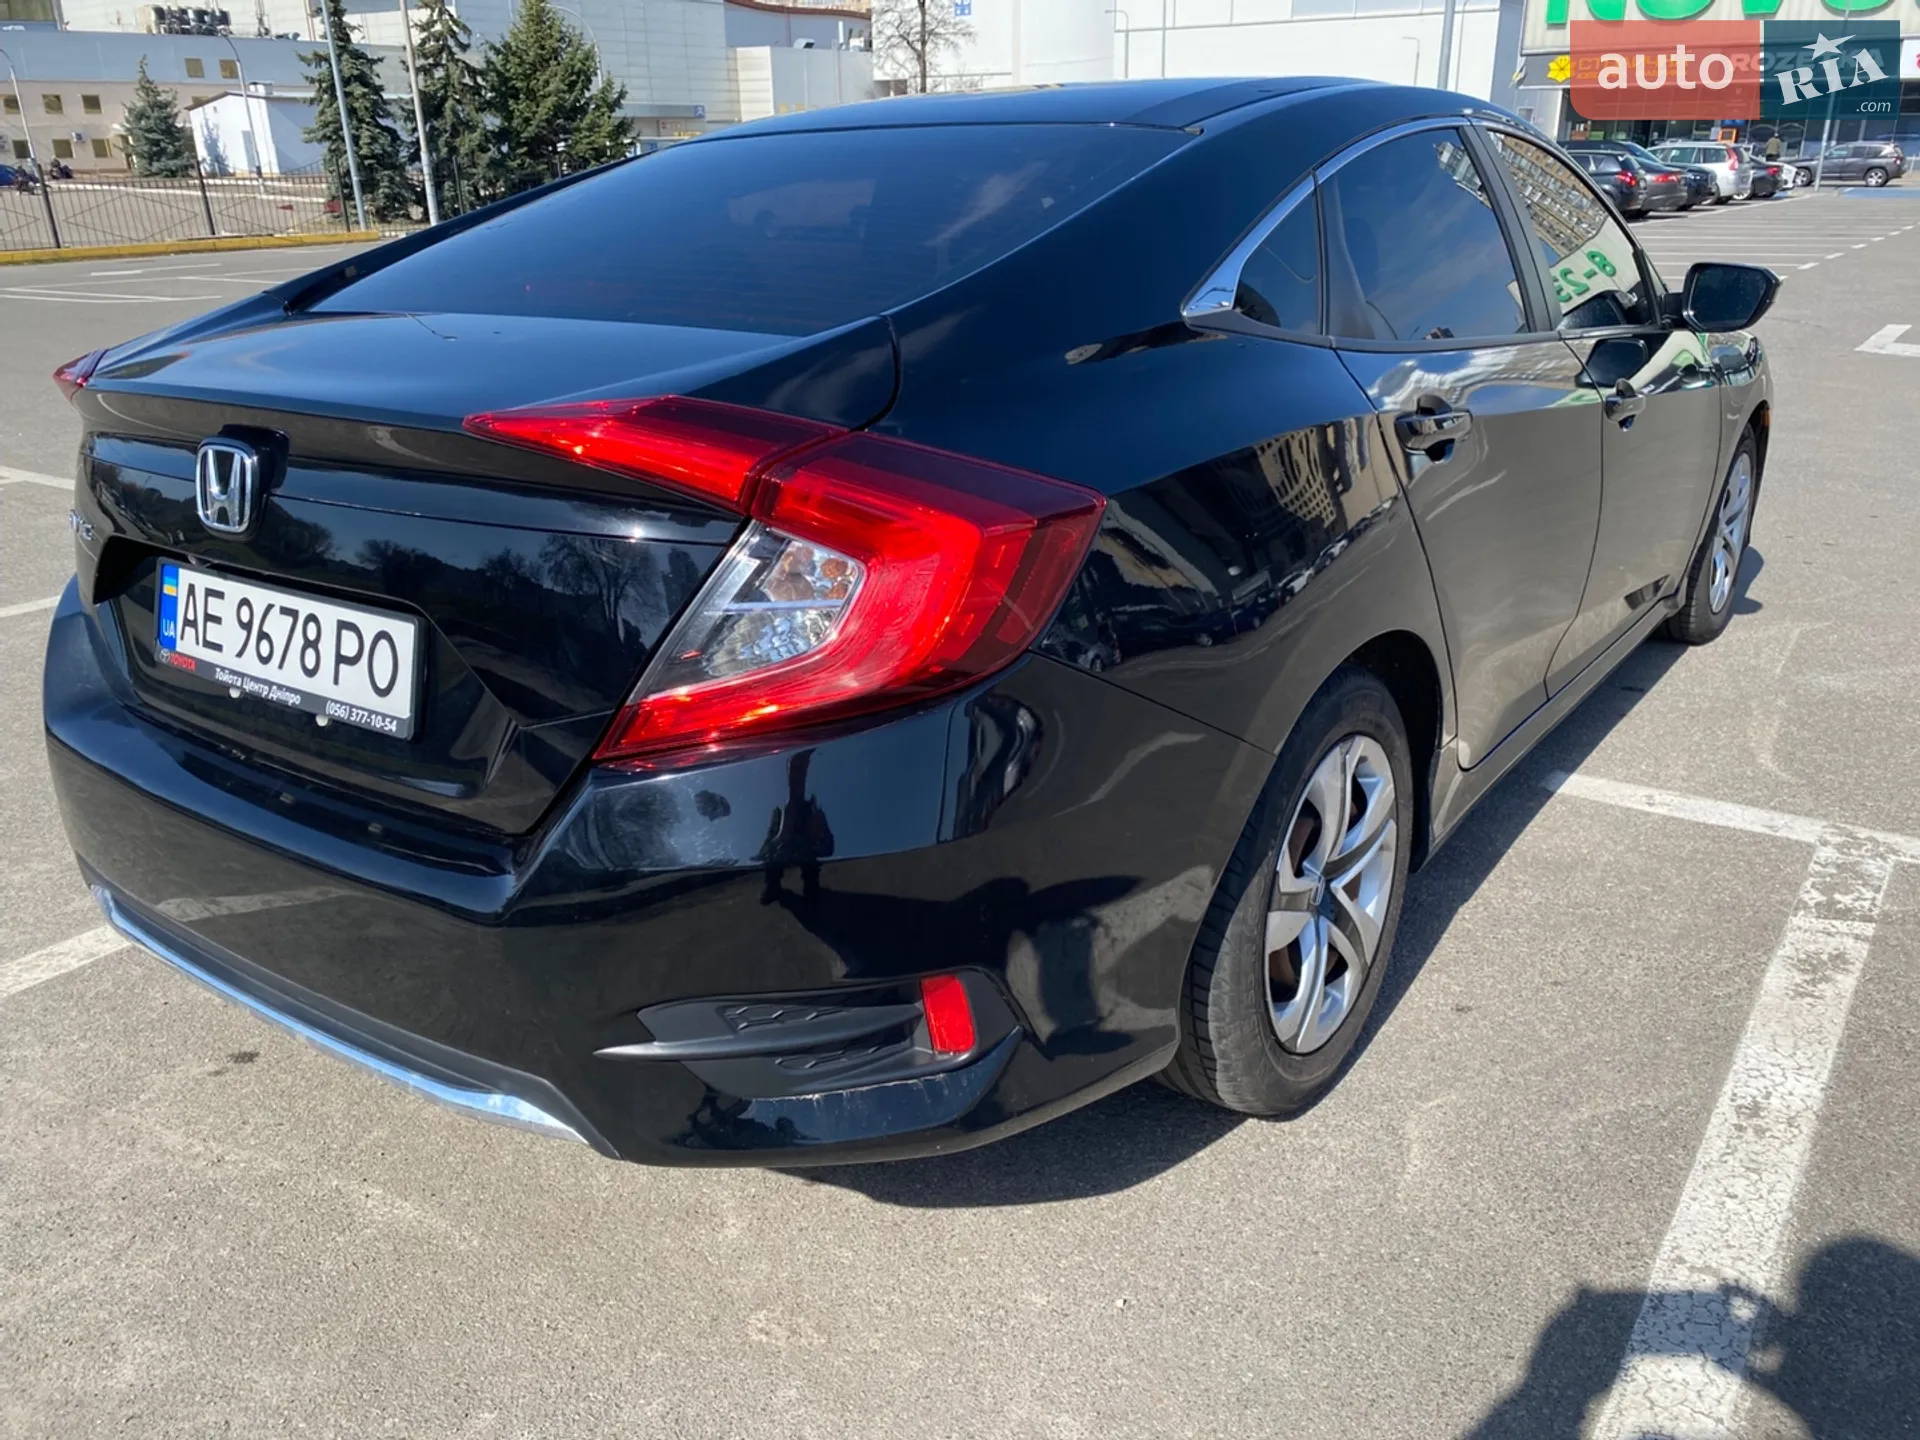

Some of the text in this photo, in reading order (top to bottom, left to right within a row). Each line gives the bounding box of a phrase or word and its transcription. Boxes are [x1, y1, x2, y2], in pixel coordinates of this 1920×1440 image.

[1731, 48, 1885, 72] ROZEKA
[162, 619, 176, 639] UA
[180, 582, 399, 699] AE 9678 PO
[169, 652, 197, 672] TOYOTA
[215, 667, 301, 706] Тойота Центр Дніпро
[325, 700, 397, 733] (056) 377-10-54
